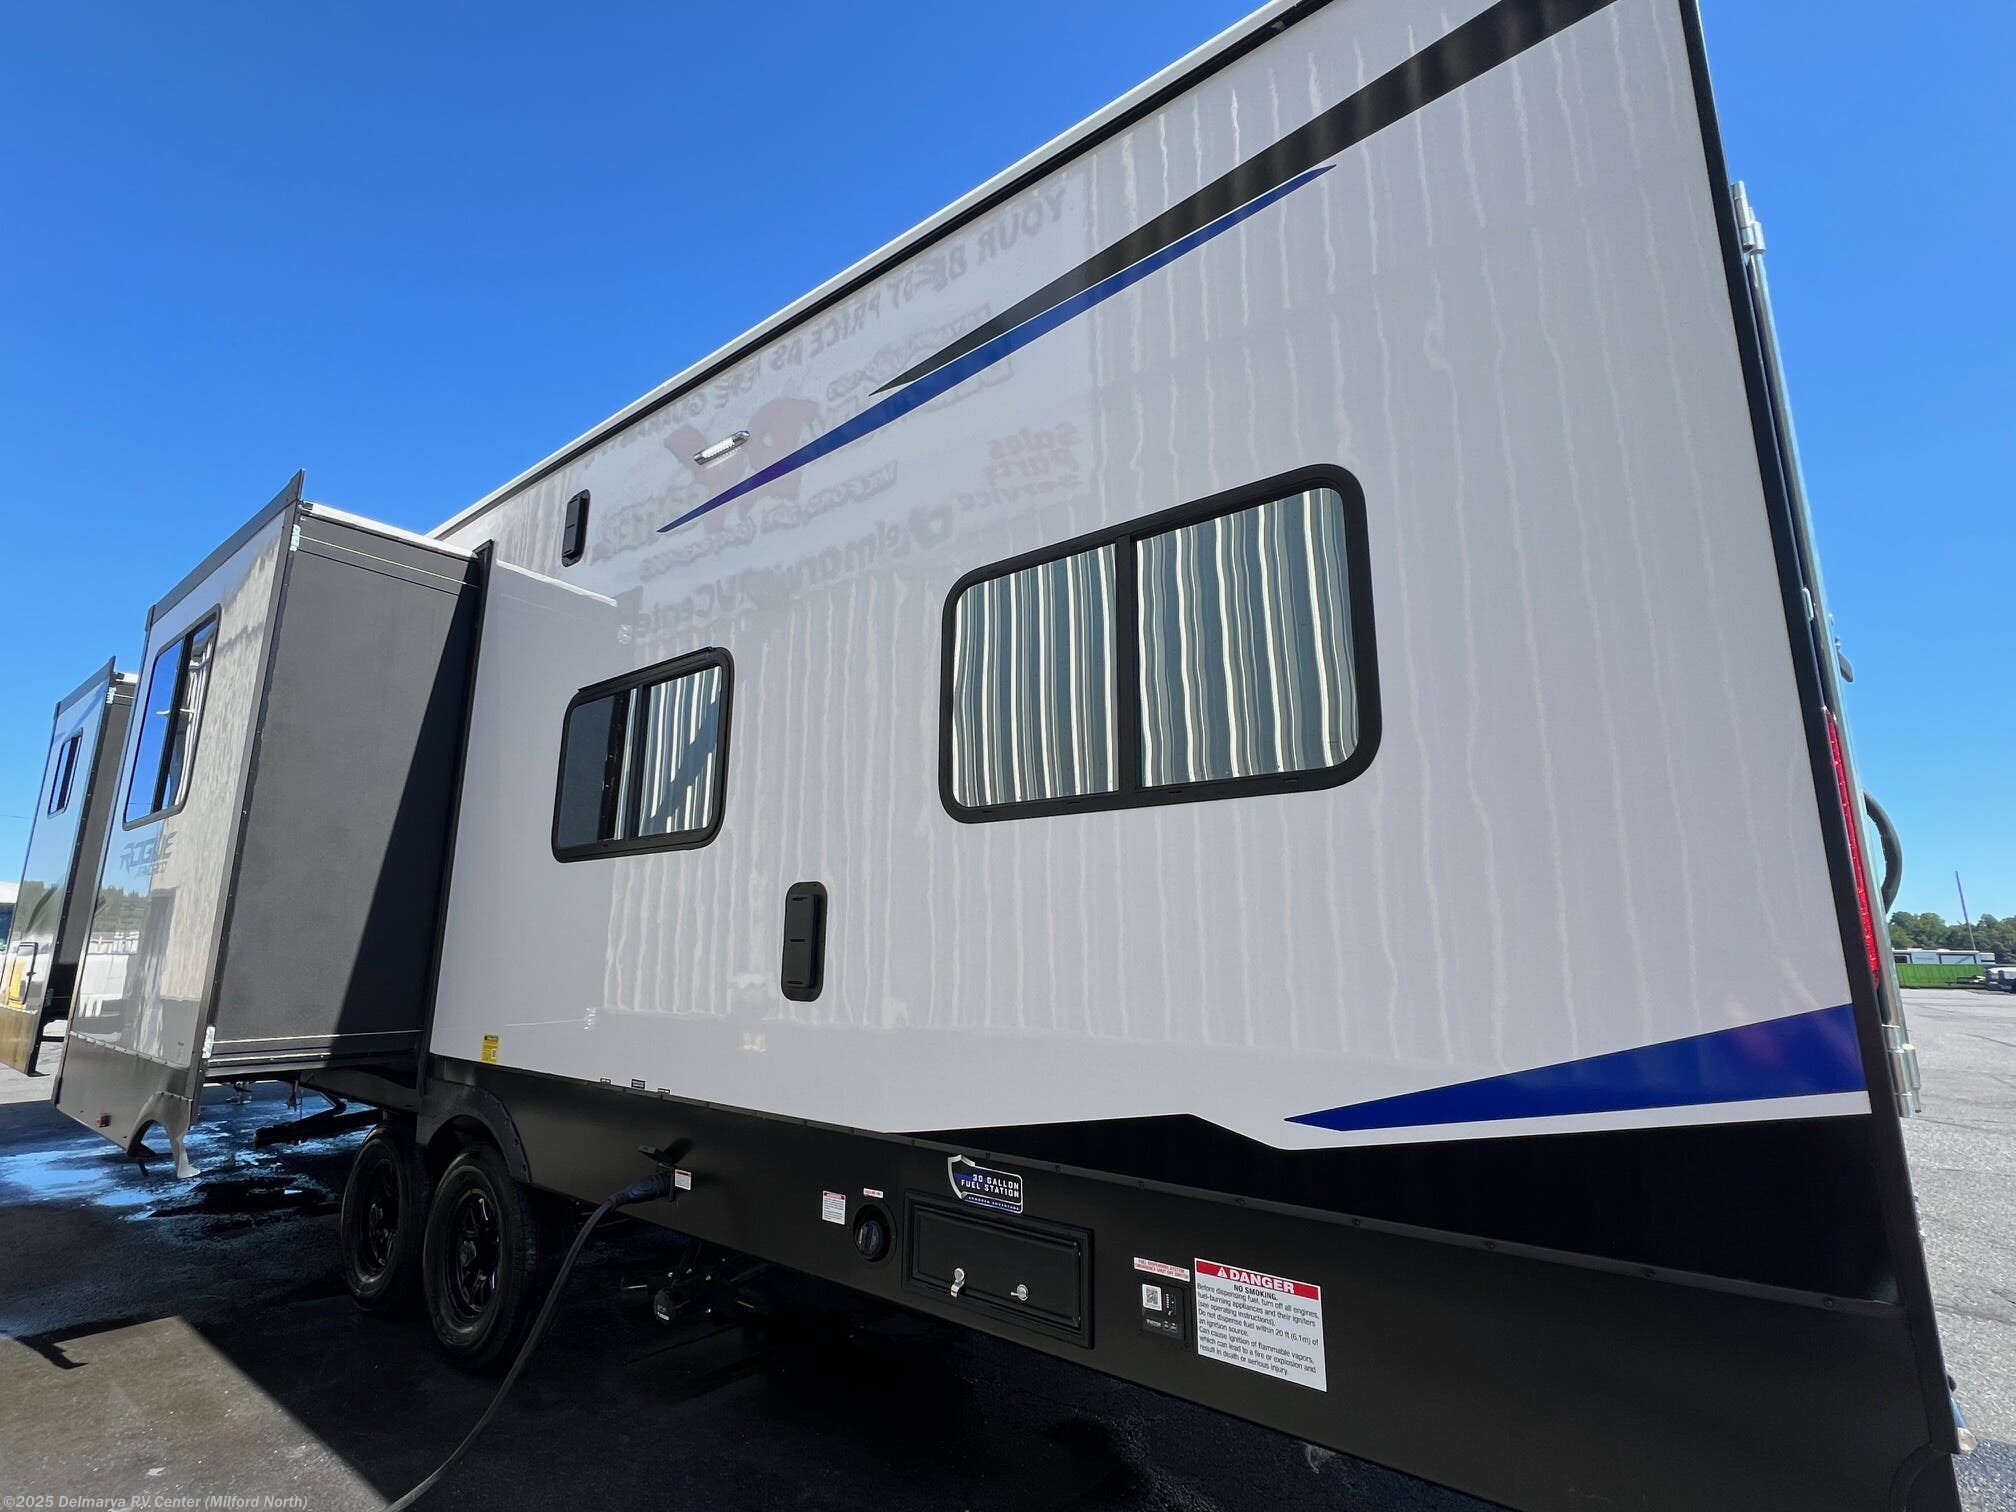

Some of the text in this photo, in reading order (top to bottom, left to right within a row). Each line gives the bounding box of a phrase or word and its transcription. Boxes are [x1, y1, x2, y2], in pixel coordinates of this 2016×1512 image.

[961, 1179, 1020, 1198] FUEL STATION
[972, 1173, 1019, 1190] 30 GALLON
[1229, 1269, 1295, 1294] DANGER
[1233, 1284, 1278, 1301] NO SMOKING.
[1197, 1283, 1215, 1293] Before
[1216, 1288, 1246, 1302] dispensing
[1261, 1298, 1274, 1306] turn
[1210, 1304, 1237, 1317] operating
[1232, 1301, 1263, 1314] appliances
[1264, 1309, 1276, 1317] and
[1277, 1311, 1291, 1320] their
[1292, 1314, 1316, 1327] igniters
[1199, 1308, 1206, 1316] Do
[1207, 1311, 1216, 1319] not
[1217, 1314, 1242, 1326] dispense
[1243, 1319, 1255, 1329] fuel
[1256, 1324, 1274, 1334] within
[1275, 1328, 1283, 1337] 20
[1311, 1338, 1319, 1346] of
[1207, 1319, 1228, 1331] ignition
[1199, 1326, 1210, 1334] Can
[1211, 1330, 1228, 1340] cause
[1229, 1333, 1250, 1345] ignition
[1258, 1342, 1291, 1357] flammable
[1199, 1336, 1216, 1345] which
[1217, 1340, 1228, 1348] can
[1229, 1343, 1242, 1352] lead
[1242, 1346, 1249, 1354] to
[1255, 1350, 1265, 1359] fire
[1273, 1356, 1303, 1369] explosion
[1303, 1365, 1317, 1373] and
[1200, 1344, 1216, 1353] result
[1222, 1351, 1240, 1360] death
[1247, 1358, 1270, 1370] serious
